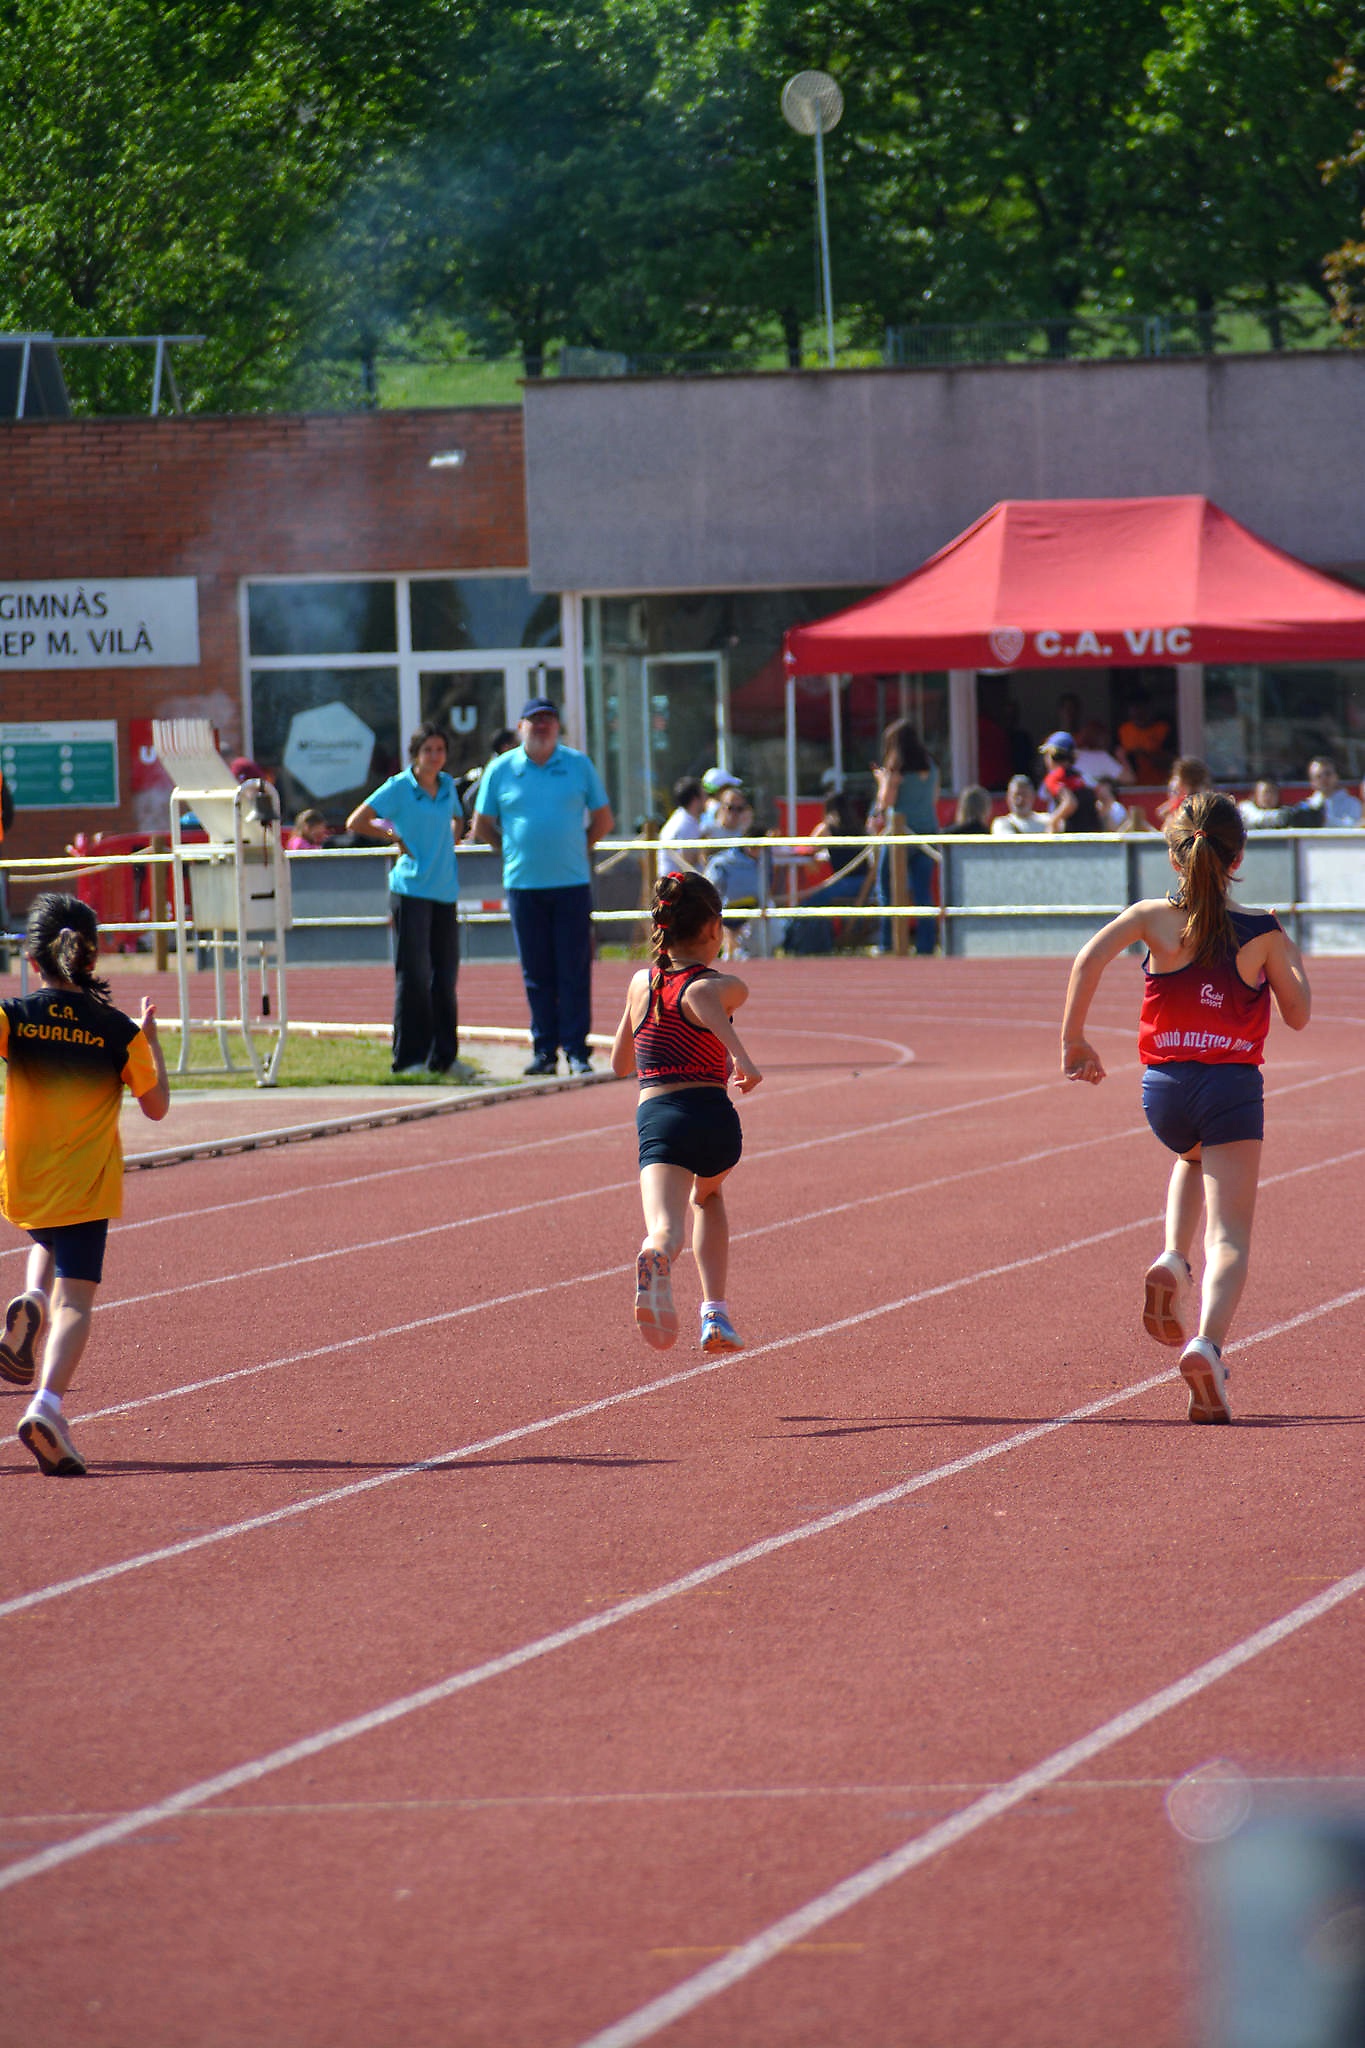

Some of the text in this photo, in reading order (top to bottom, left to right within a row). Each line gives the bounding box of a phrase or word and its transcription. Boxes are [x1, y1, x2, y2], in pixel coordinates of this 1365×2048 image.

[0, 586, 108, 620] GIMNÀS
[0, 621, 153, 656] EP M. VILÀ
[1034, 627, 1192, 657] C.A. VIC
[48, 1003, 79, 1022] C.A.
